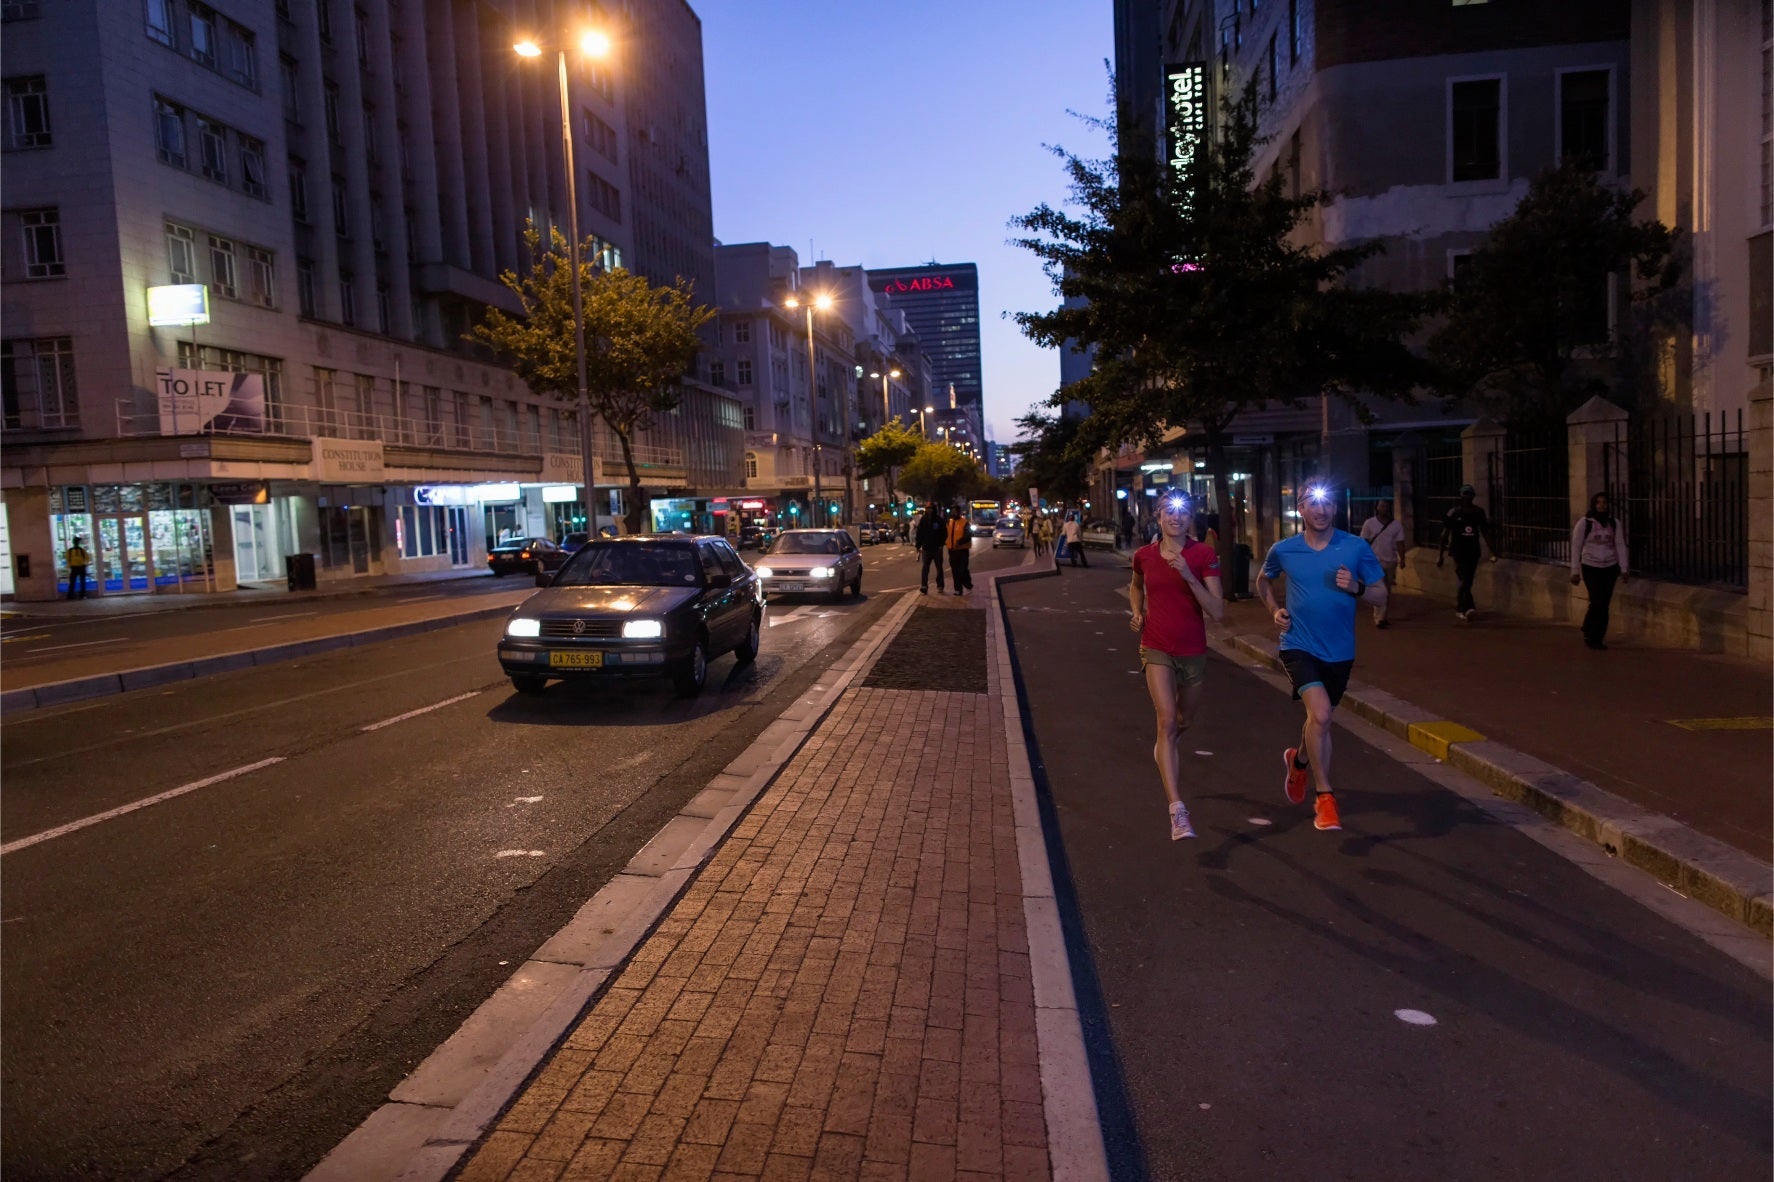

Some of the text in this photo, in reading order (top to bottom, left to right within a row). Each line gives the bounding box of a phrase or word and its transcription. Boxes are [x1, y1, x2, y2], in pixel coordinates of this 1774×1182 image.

[1194, 66, 1204, 129] CAPE TOWN
[910, 276, 953, 291] ABSA
[160, 379, 226, 397] TO LET
[322, 449, 382, 461] CONSTITUTION
[338, 461, 366, 472] HOUSE
[566, 469, 584, 482] HOU
[553, 654, 600, 664] CA 765-993
